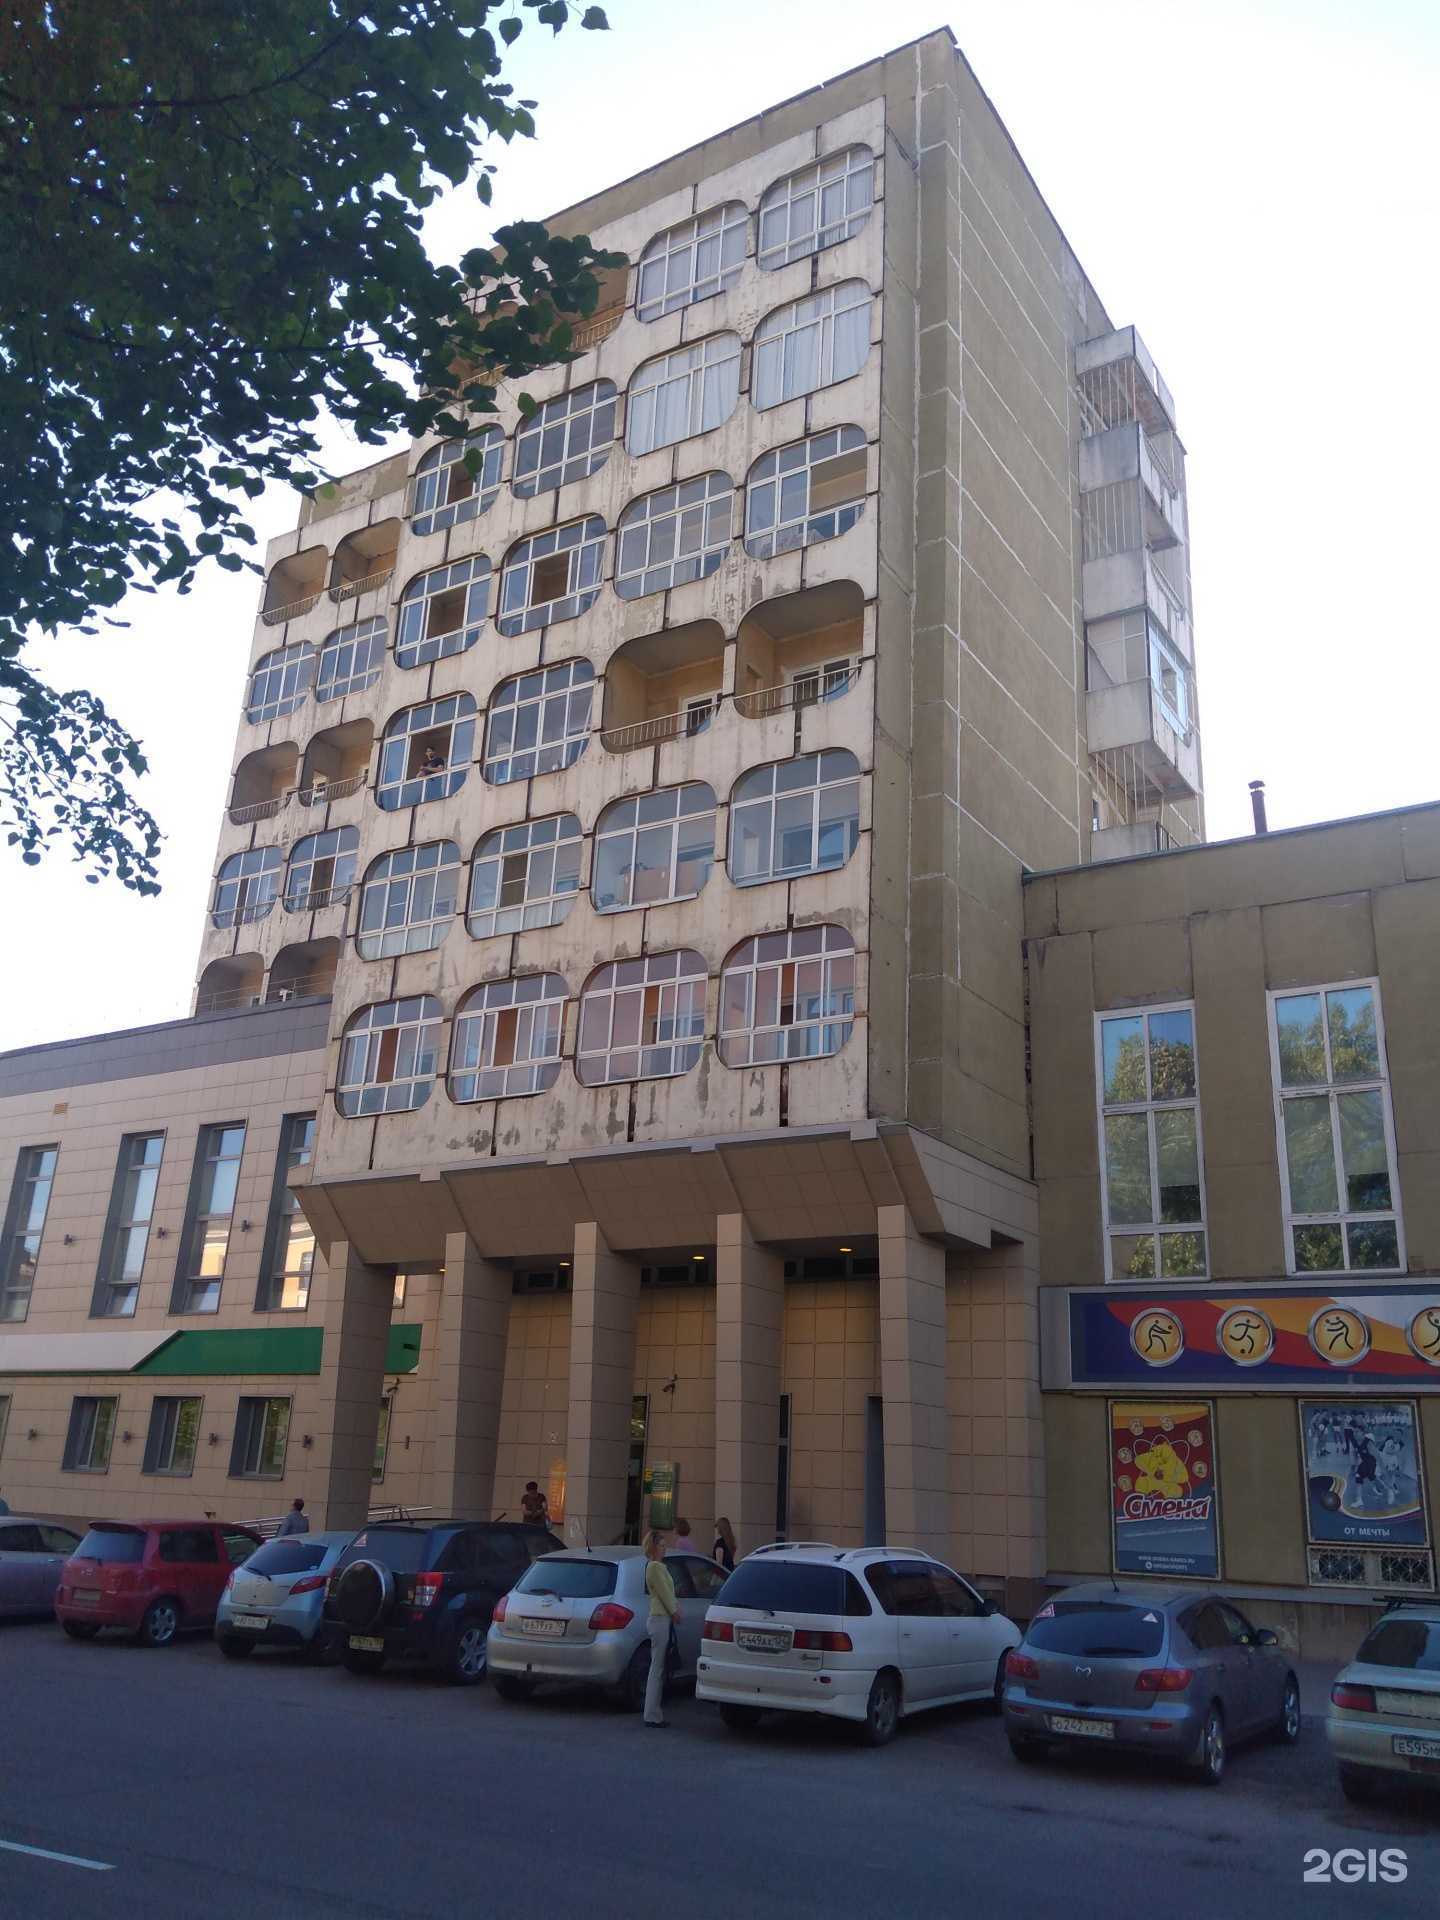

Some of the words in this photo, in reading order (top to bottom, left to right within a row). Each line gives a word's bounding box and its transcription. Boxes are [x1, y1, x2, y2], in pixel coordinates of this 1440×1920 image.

[1124, 1494, 1211, 1520] Смена
[1343, 1527, 1356, 1535] ОТ
[1359, 1527, 1391, 1537] МЕЧТЫ
